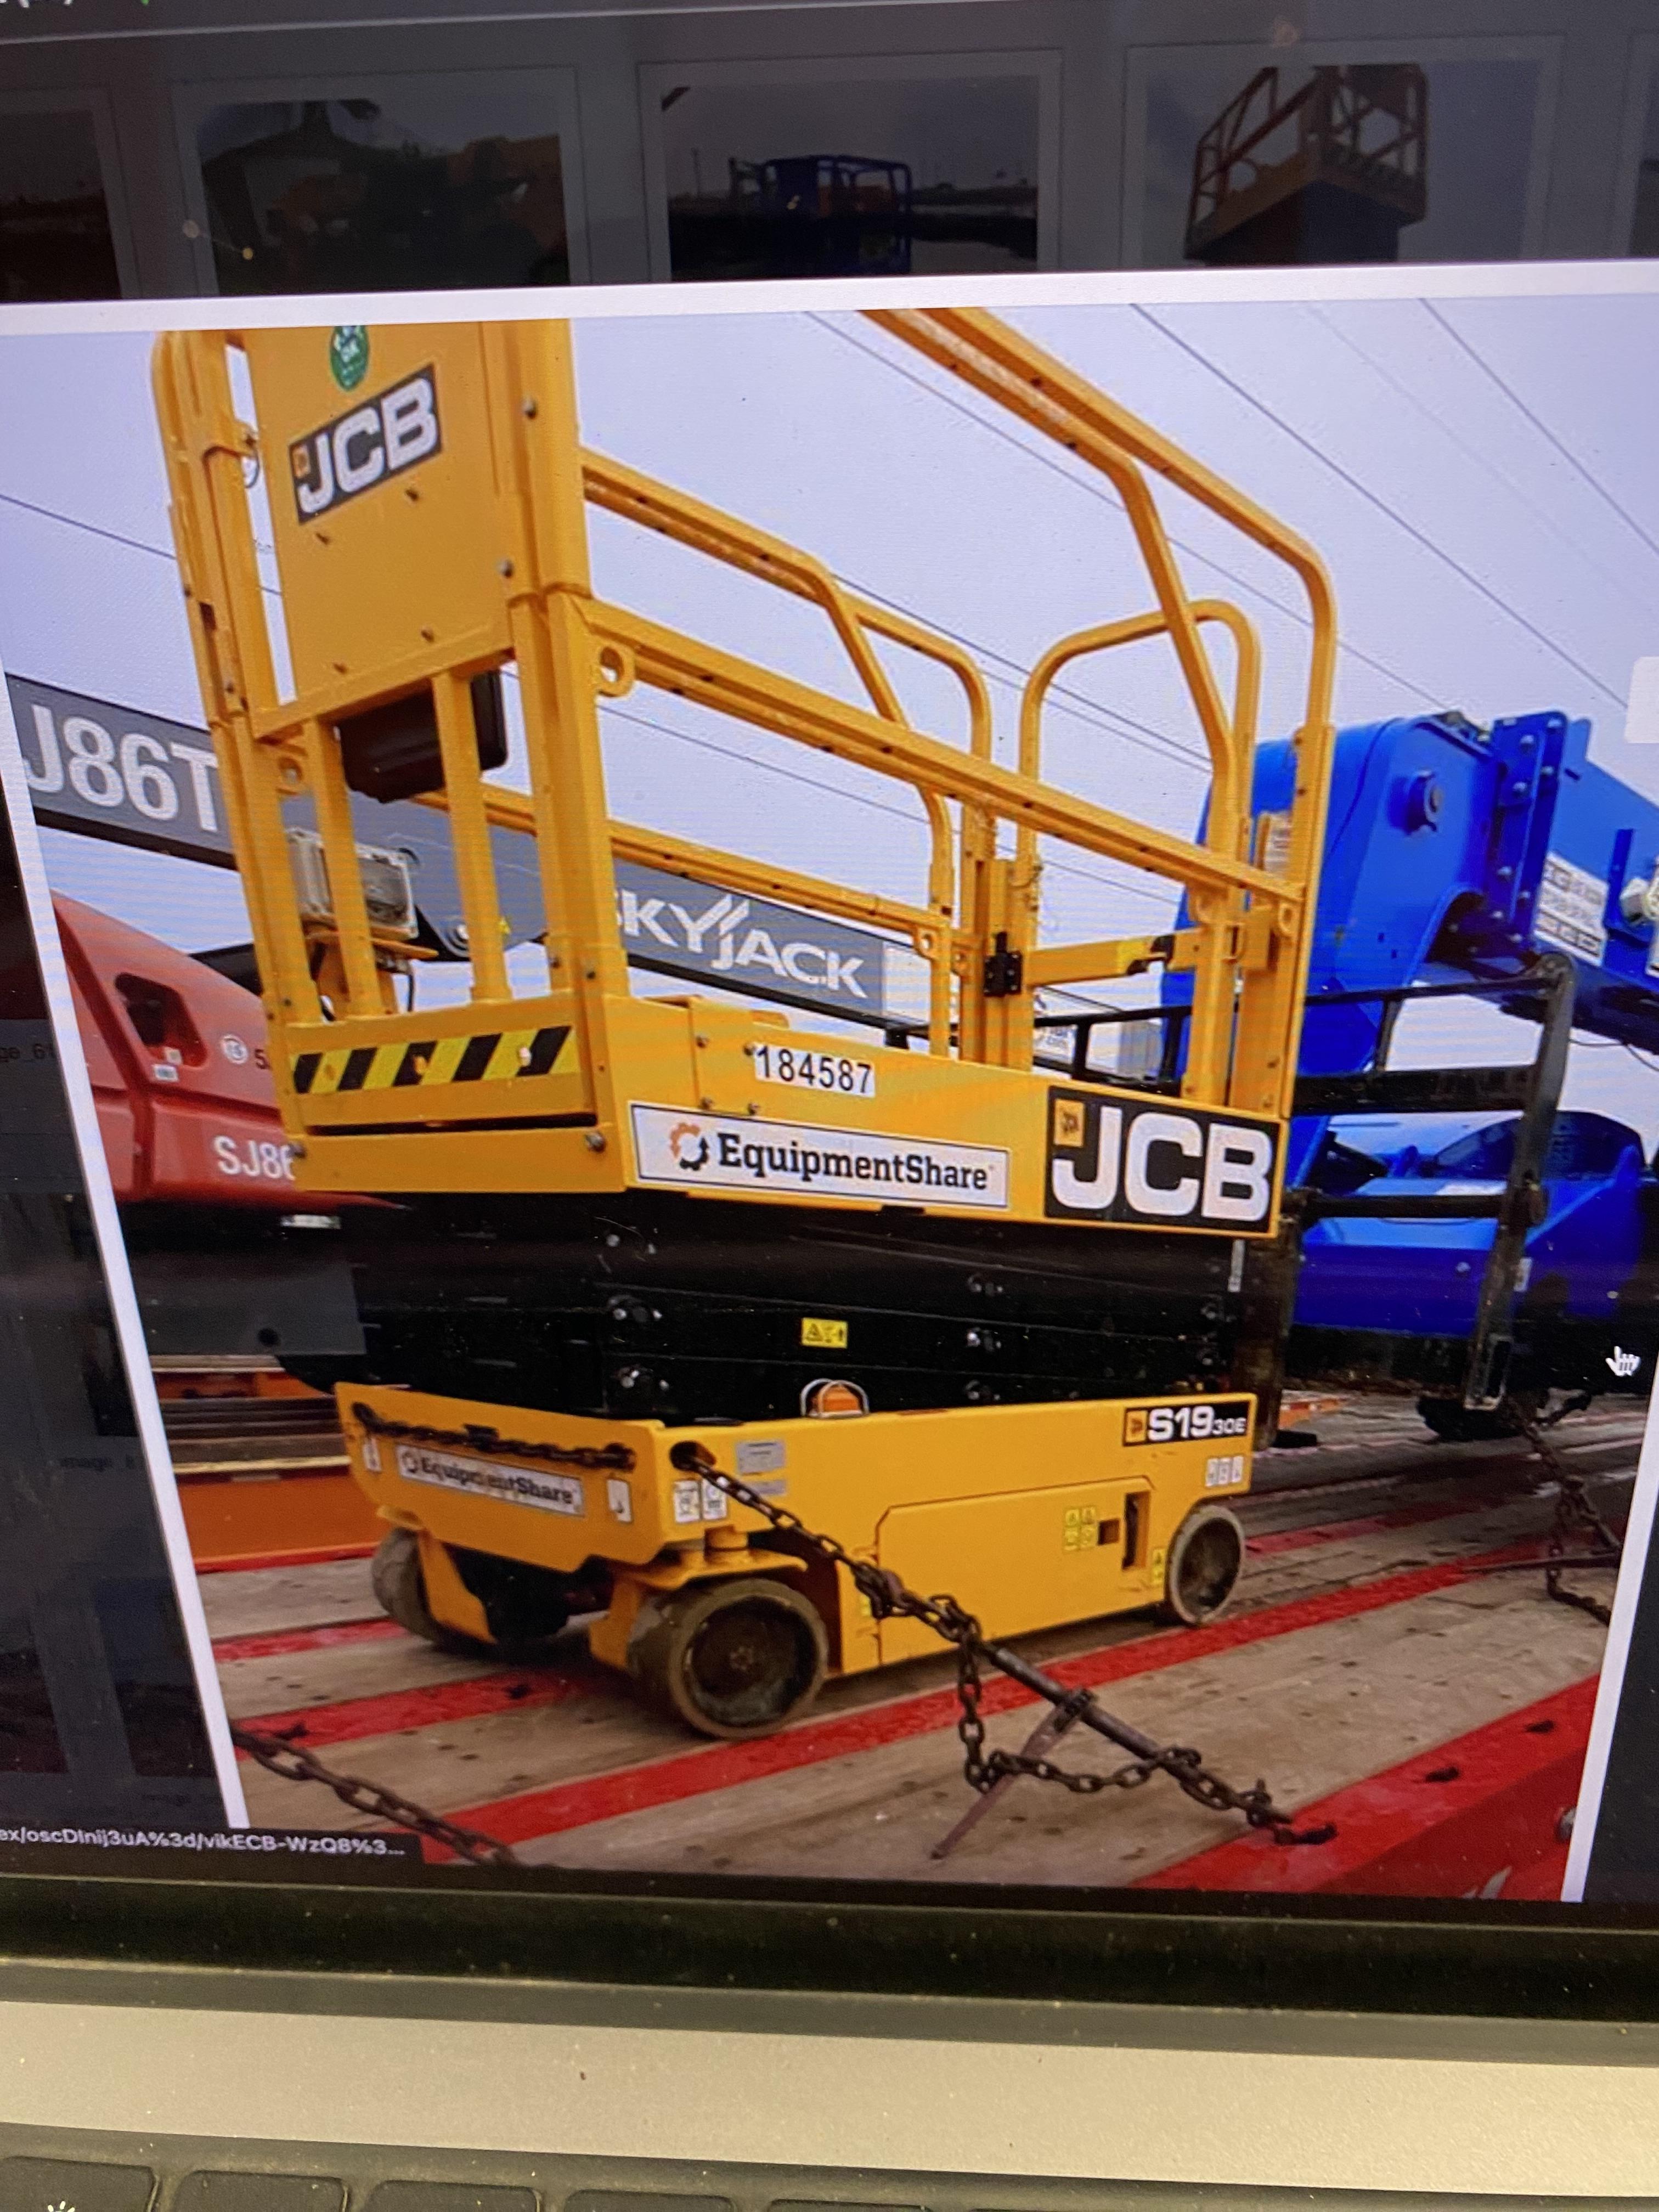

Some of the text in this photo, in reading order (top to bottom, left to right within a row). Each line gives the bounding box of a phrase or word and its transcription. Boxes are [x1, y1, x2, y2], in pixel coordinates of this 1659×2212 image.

[298, 378, 437, 514] JCB
[615, 888, 868, 998] KYJACK
[757, 1046, 871, 1093] 184587
[717, 1132, 987, 1190] EquipmentShare
[1052, 1106, 1272, 1221] JCB
